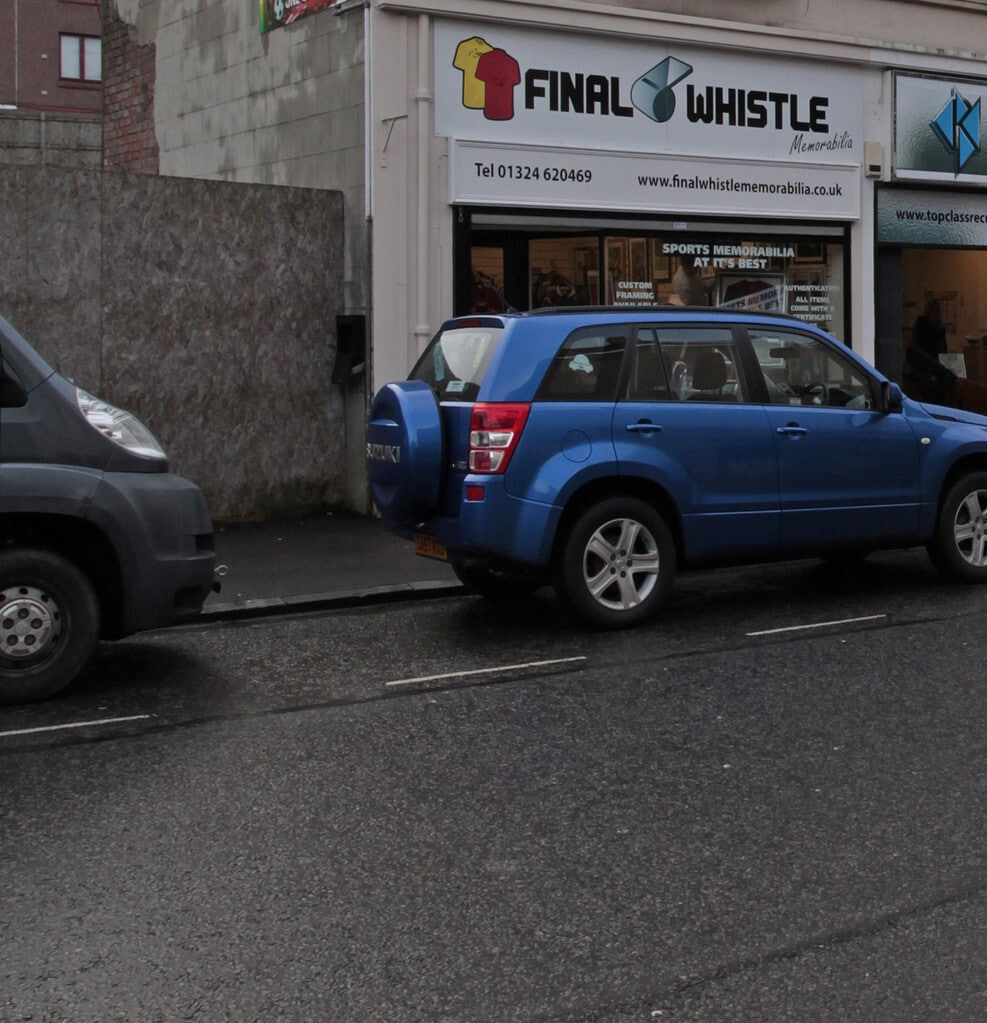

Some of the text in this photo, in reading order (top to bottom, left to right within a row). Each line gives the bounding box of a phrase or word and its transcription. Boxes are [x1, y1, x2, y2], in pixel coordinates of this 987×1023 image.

[525, 68, 829, 134] FINAL WHISTLE
[789, 133, 854, 156] Memorabilia
[475, 162, 592, 184] Tel 01324 620469
[638, 173, 843, 197] www.finalwhistlememorabilia.co.uk
[663, 243, 795, 257] SPORTS MEMORABILIA
[693, 257, 767, 269] AT IT'S BEST
[618, 281, 652, 289] CUSTOM
[616, 291, 654, 299] FRAMING
